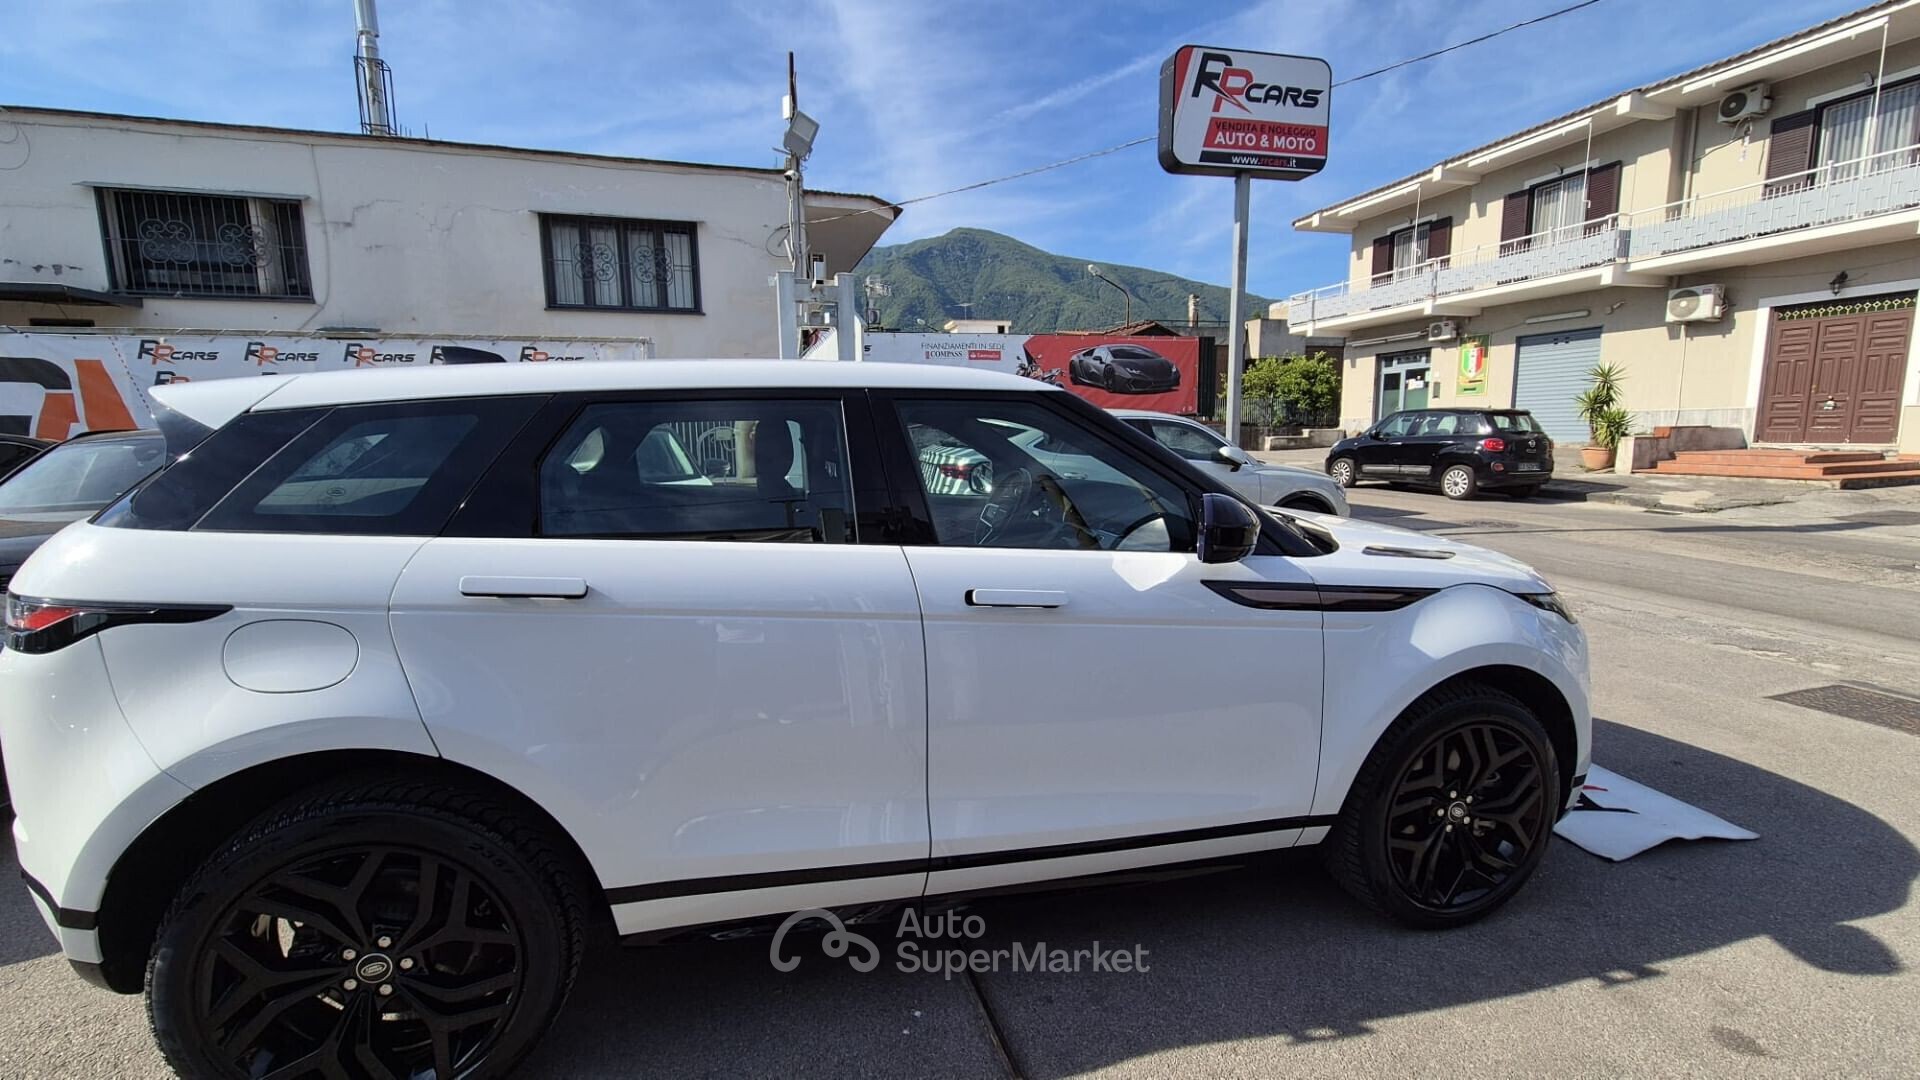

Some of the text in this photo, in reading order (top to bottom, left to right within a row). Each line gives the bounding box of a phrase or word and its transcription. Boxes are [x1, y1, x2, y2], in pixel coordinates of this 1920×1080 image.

[1215, 121, 1317, 137] VENDITA E NOLEGGIO
[1214, 132, 1316, 151] AUTO & MOTO
[1231, 155, 1297, 168] www.rrcars.it
[921, 342, 977, 351] FINANZIAMENTI
[988, 342, 1006, 351] SEDE
